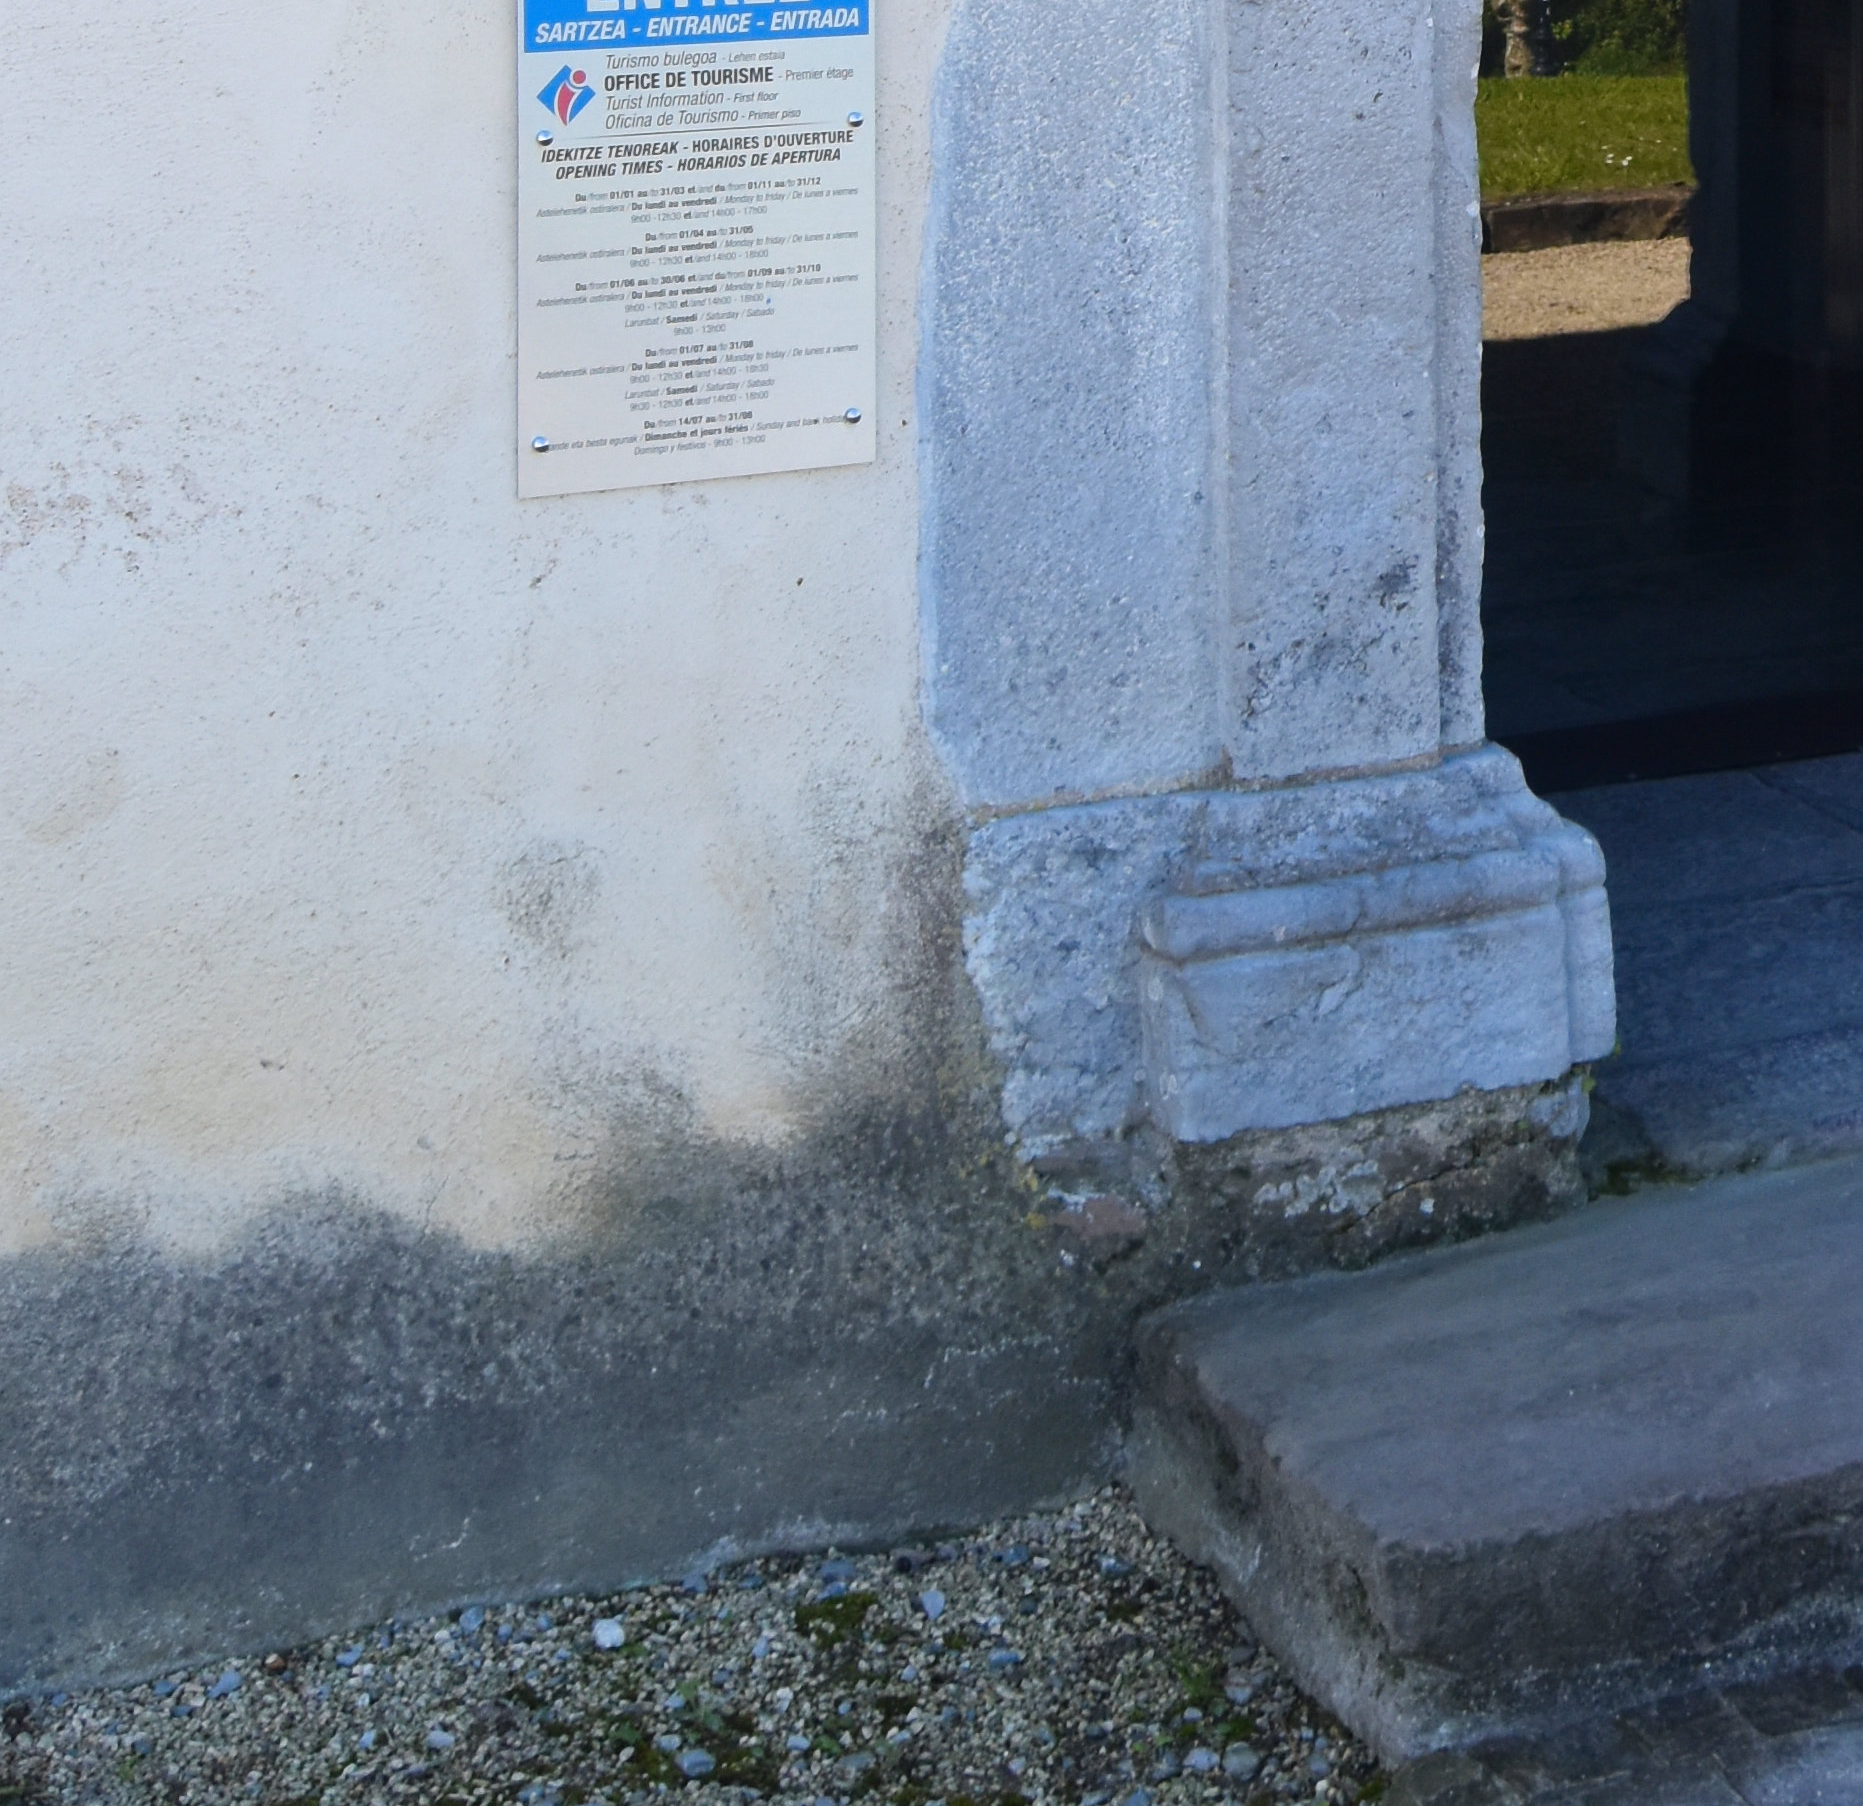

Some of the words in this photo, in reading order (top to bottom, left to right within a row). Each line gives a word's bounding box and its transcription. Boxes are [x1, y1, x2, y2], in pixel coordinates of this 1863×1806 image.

[535, 19, 626, 43] SARTZEA
[646, 12, 752, 37] ENTRANCE
[770, 7, 859, 31] ENTRADA
[606, 53, 660, 69] Turismo
[663, 50, 717, 67] bulegoa
[605, 72, 660, 92] OFFICE
[666, 71, 686, 88] DE
[691, 66, 773, 86] TOURISME
[785, 69, 824, 82] Premier
[826, 67, 854, 81] étage
[605, 94, 643, 111] Turist
[646, 91, 724, 108] Information
[733, 92, 755, 103] First
[605, 113, 653, 130] Oficina
[656, 111, 674, 127] de
[679, 109, 739, 125] Tourismo
[748, 110, 779, 121] Primer
[541, 145, 603, 163] IDEKITZE
[607, 141, 679, 159] TENOREAK
[692, 136, 759, 153] HORAIRES
[764, 129, 854, 148] D'OUVERTURE
[555, 163, 617, 180] OPENING
[622, 159, 664, 176] TIMES
[677, 154, 747, 172] HORARIOS
[750, 152, 769, 167] DE
[771, 148, 841, 165] APERTURA
[747, 180, 772, 190] 01/11
[796, 176, 821, 187] 31/12
